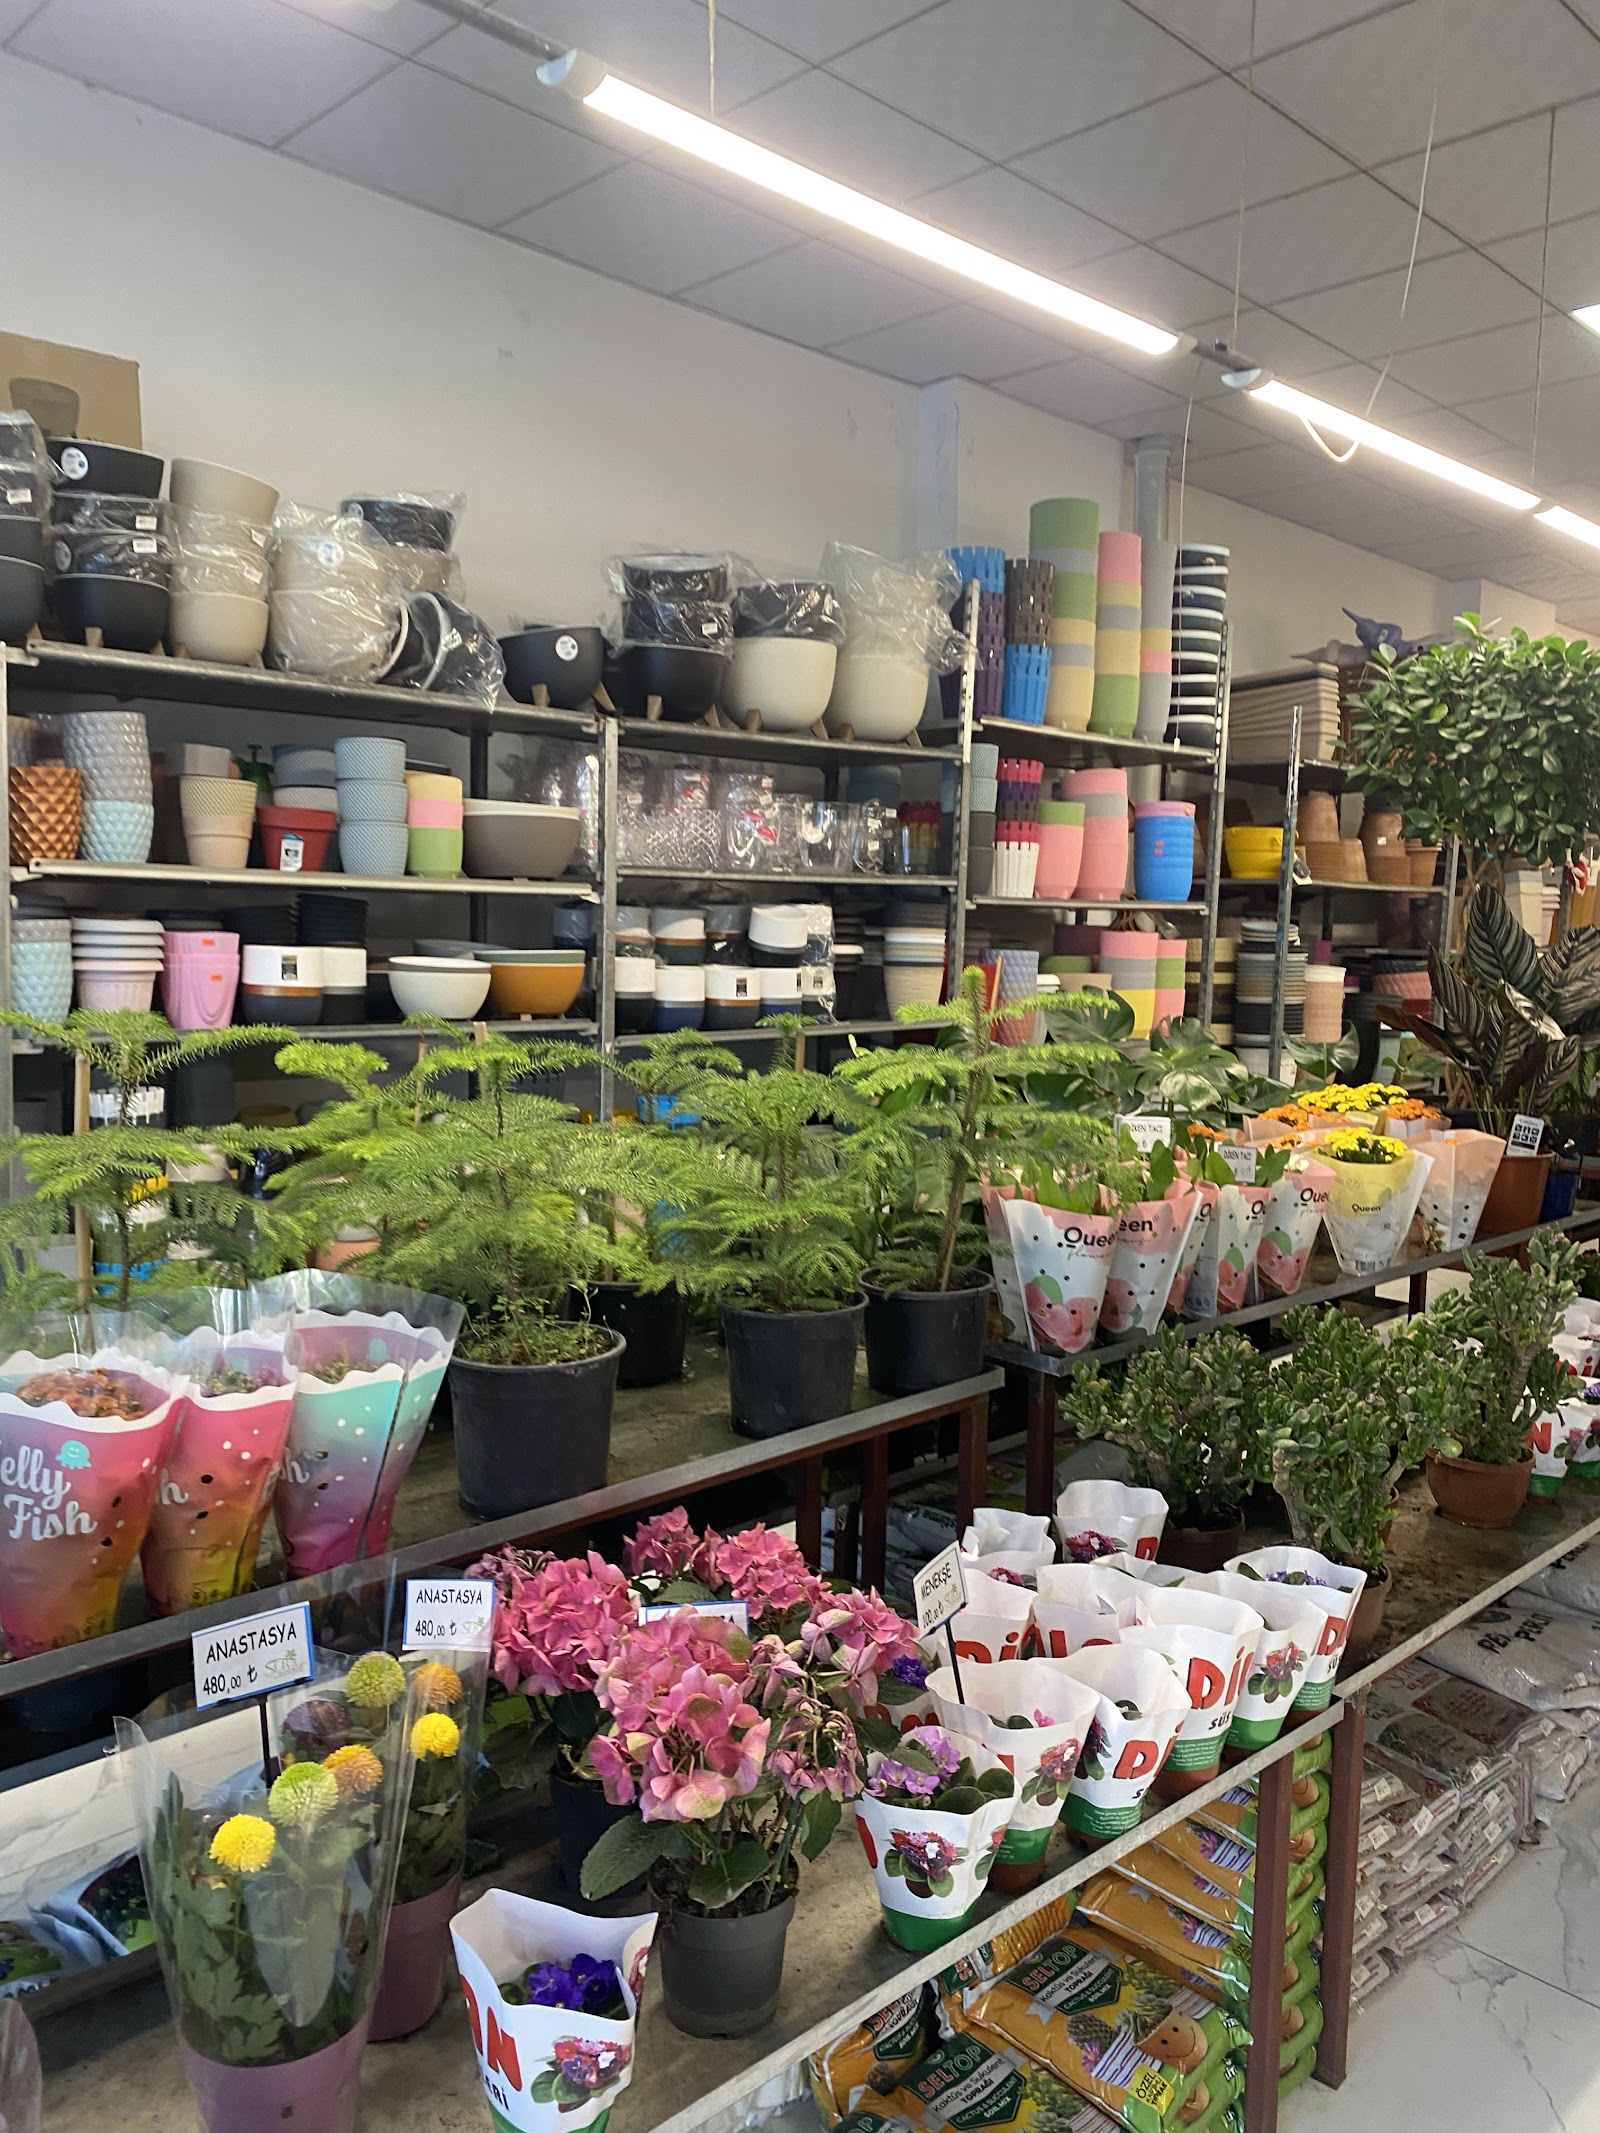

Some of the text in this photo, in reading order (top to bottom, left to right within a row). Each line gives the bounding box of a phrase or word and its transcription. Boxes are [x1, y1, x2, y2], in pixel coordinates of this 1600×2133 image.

[1351, 1203, 1382, 1214] Queen
[0, 1444, 71, 1510] elly
[4, 1493, 98, 1541] Fish
[415, 1588, 482, 1605] ANASTASYA
[206, 1621, 297, 1664] ANASTASYA
[1022, 1944, 1078, 1991] SELTOP
[918, 2045, 981, 2100] SELTOP
[1135, 2072, 1157, 2099] ÖZEL
[933, 2088, 963, 2113] Kaktüs
[960, 2081, 973, 2093] ve
[961, 2078, 995, 2105] TOPRAĞI
